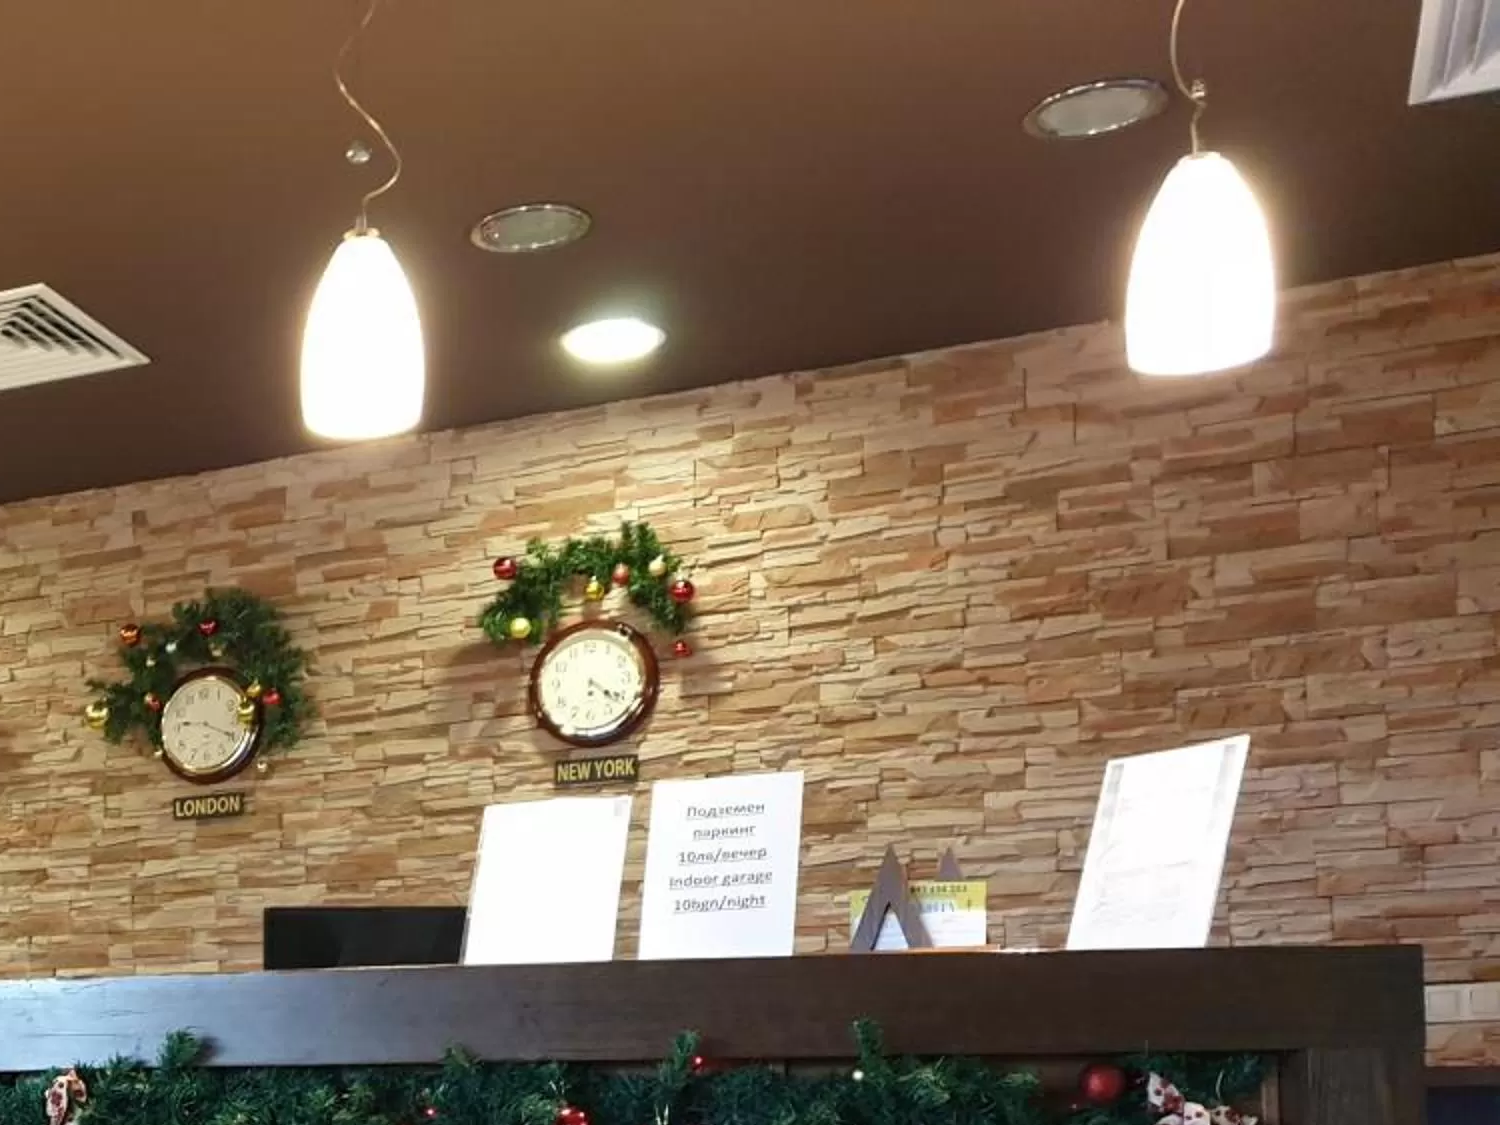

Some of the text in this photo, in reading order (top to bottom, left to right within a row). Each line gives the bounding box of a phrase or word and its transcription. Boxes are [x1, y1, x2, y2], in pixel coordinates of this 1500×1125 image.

[557, 757, 635, 782] NEW YORK
[175, 796, 240, 817] LONDON
[687, 803, 765, 818] Подземен
[721, 871, 773, 887] garage
[674, 895, 766, 913] 10bgn/night
